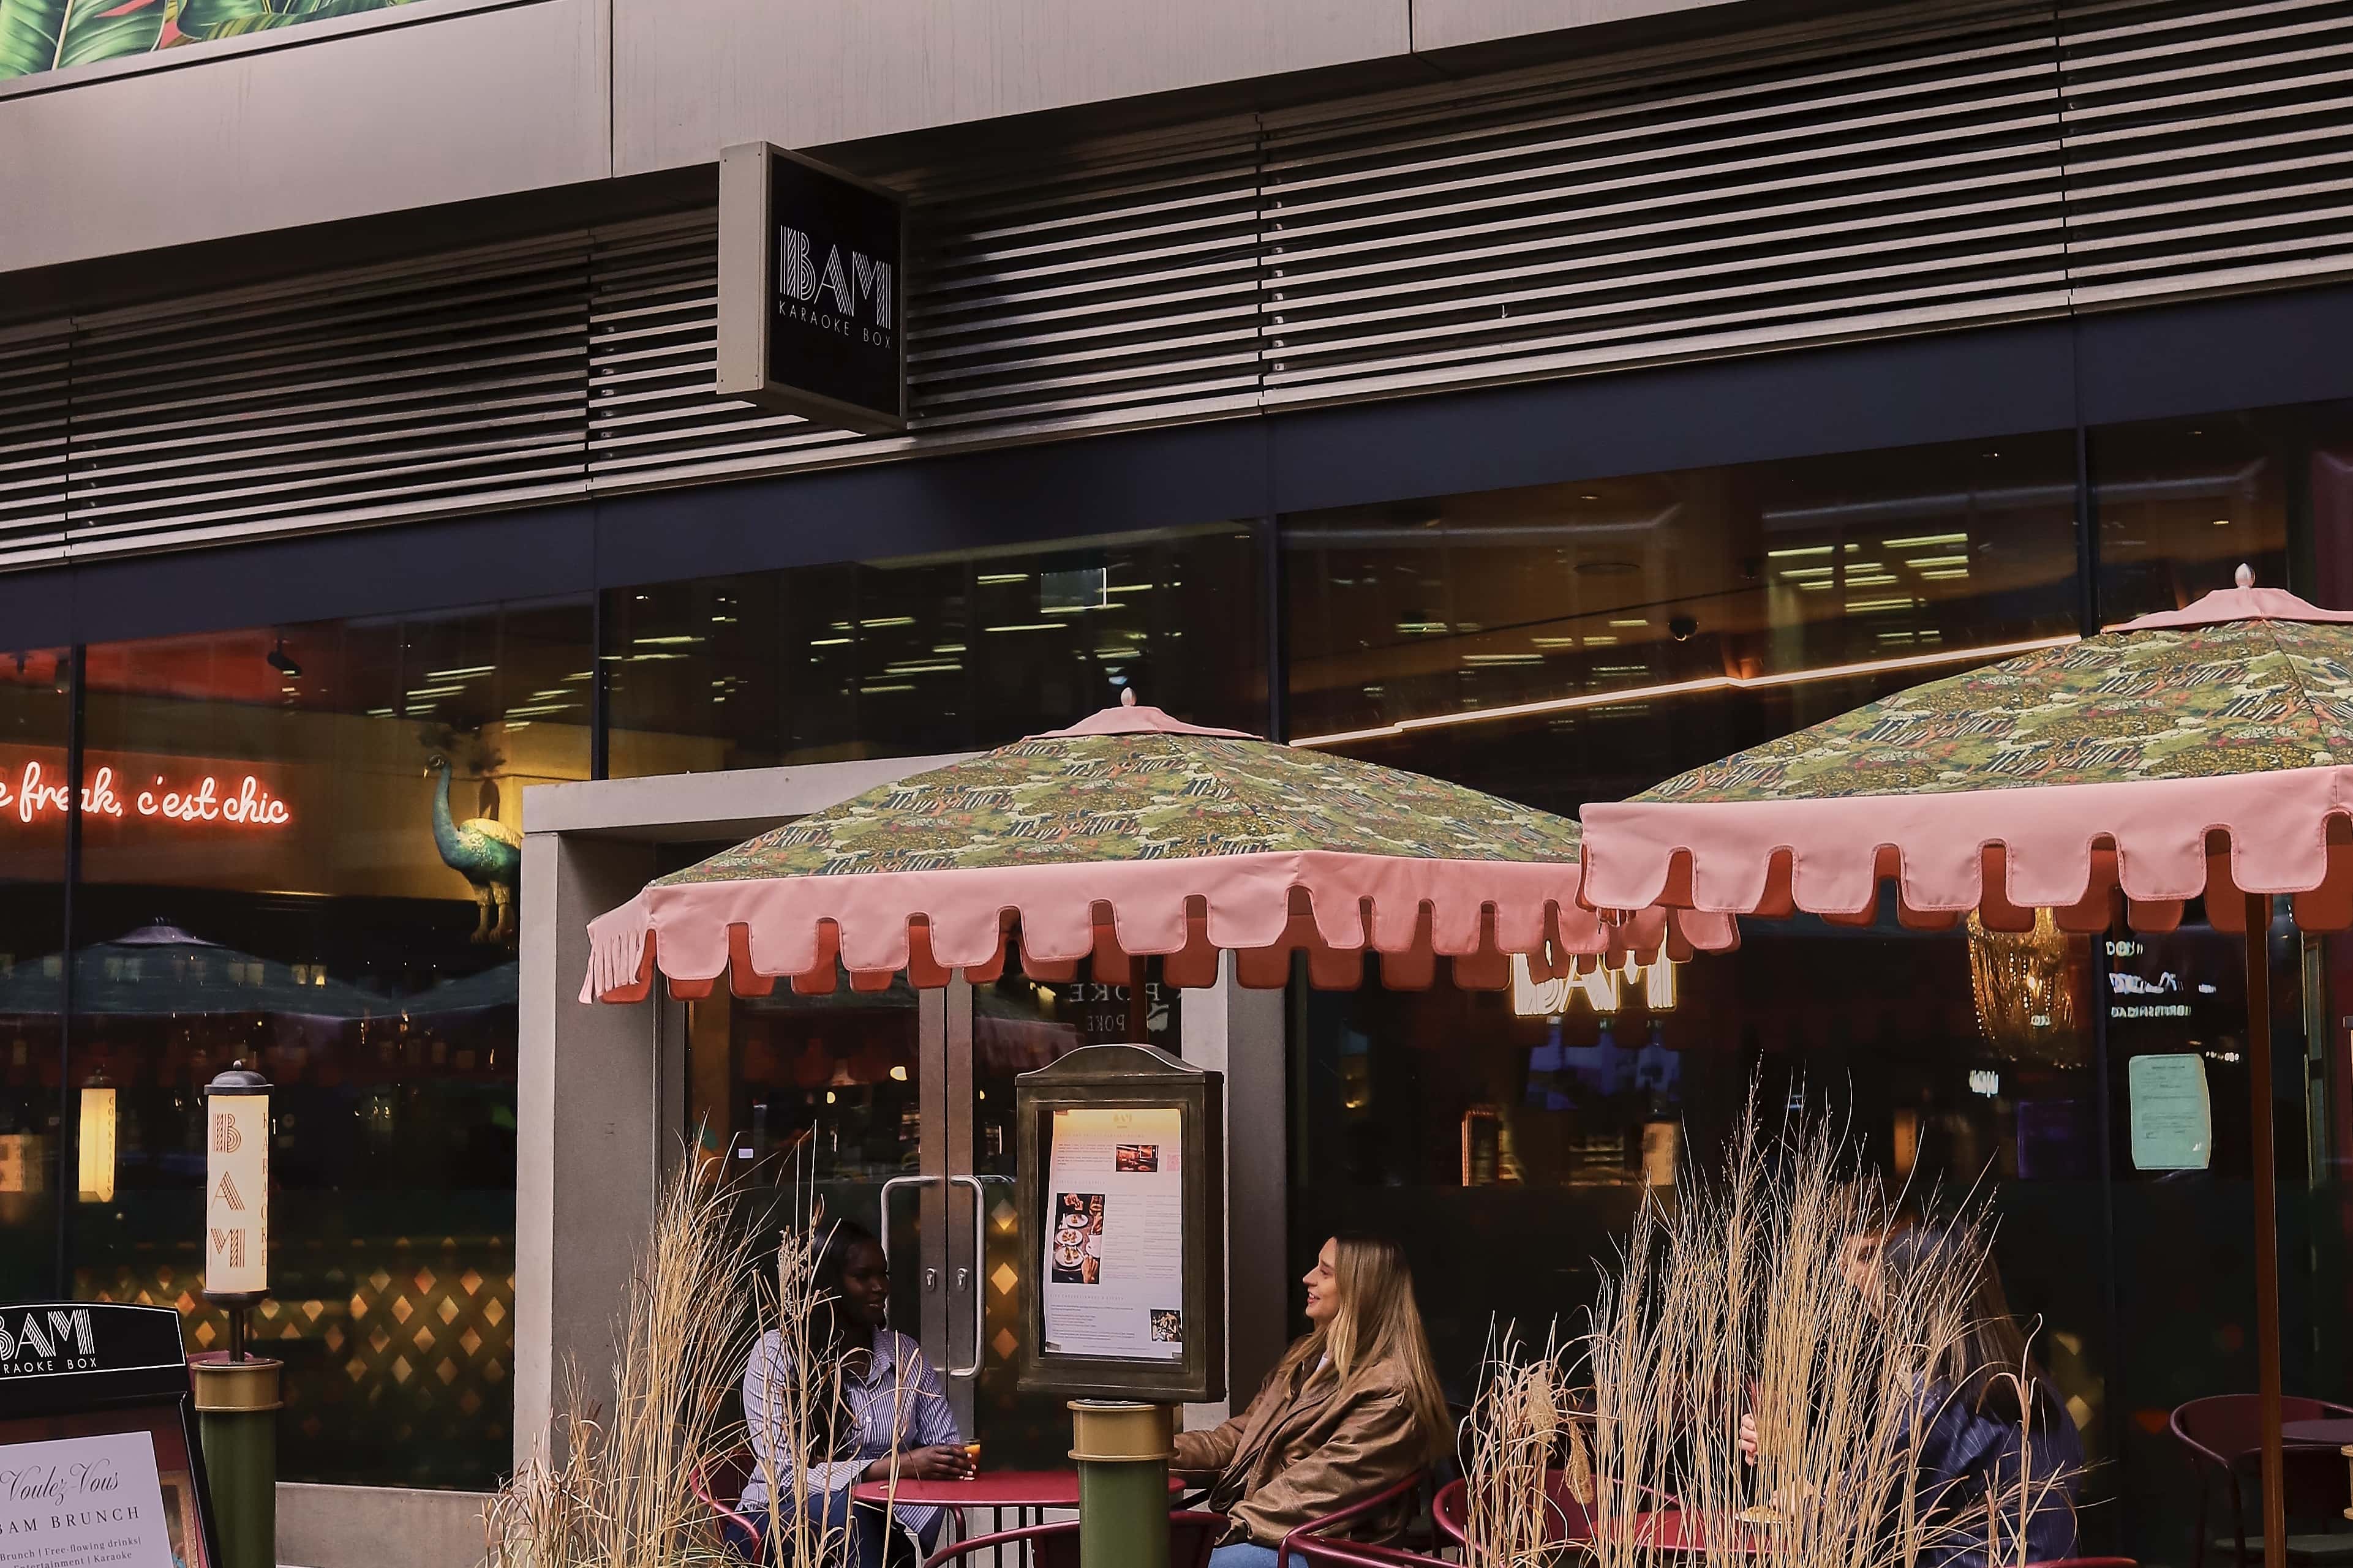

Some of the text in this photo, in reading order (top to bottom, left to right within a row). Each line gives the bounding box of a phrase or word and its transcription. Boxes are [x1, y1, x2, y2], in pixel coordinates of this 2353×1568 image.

[780, 225, 891, 330] BAM
[779, 300, 890, 349] KARAOKE BOX
[137, 775, 219, 821] c'est
[222, 775, 289, 824] chic
[209, 1113, 246, 1268] BAM
[67, 1357, 97, 1370] BOX
[0, 1506, 140, 1534] AM BRUNCH
[0, 1550, 35, 1561] Brunch
[45, 1542, 105, 1556] Free-flowing
[94, 1551, 132, 1563] Karaoke
